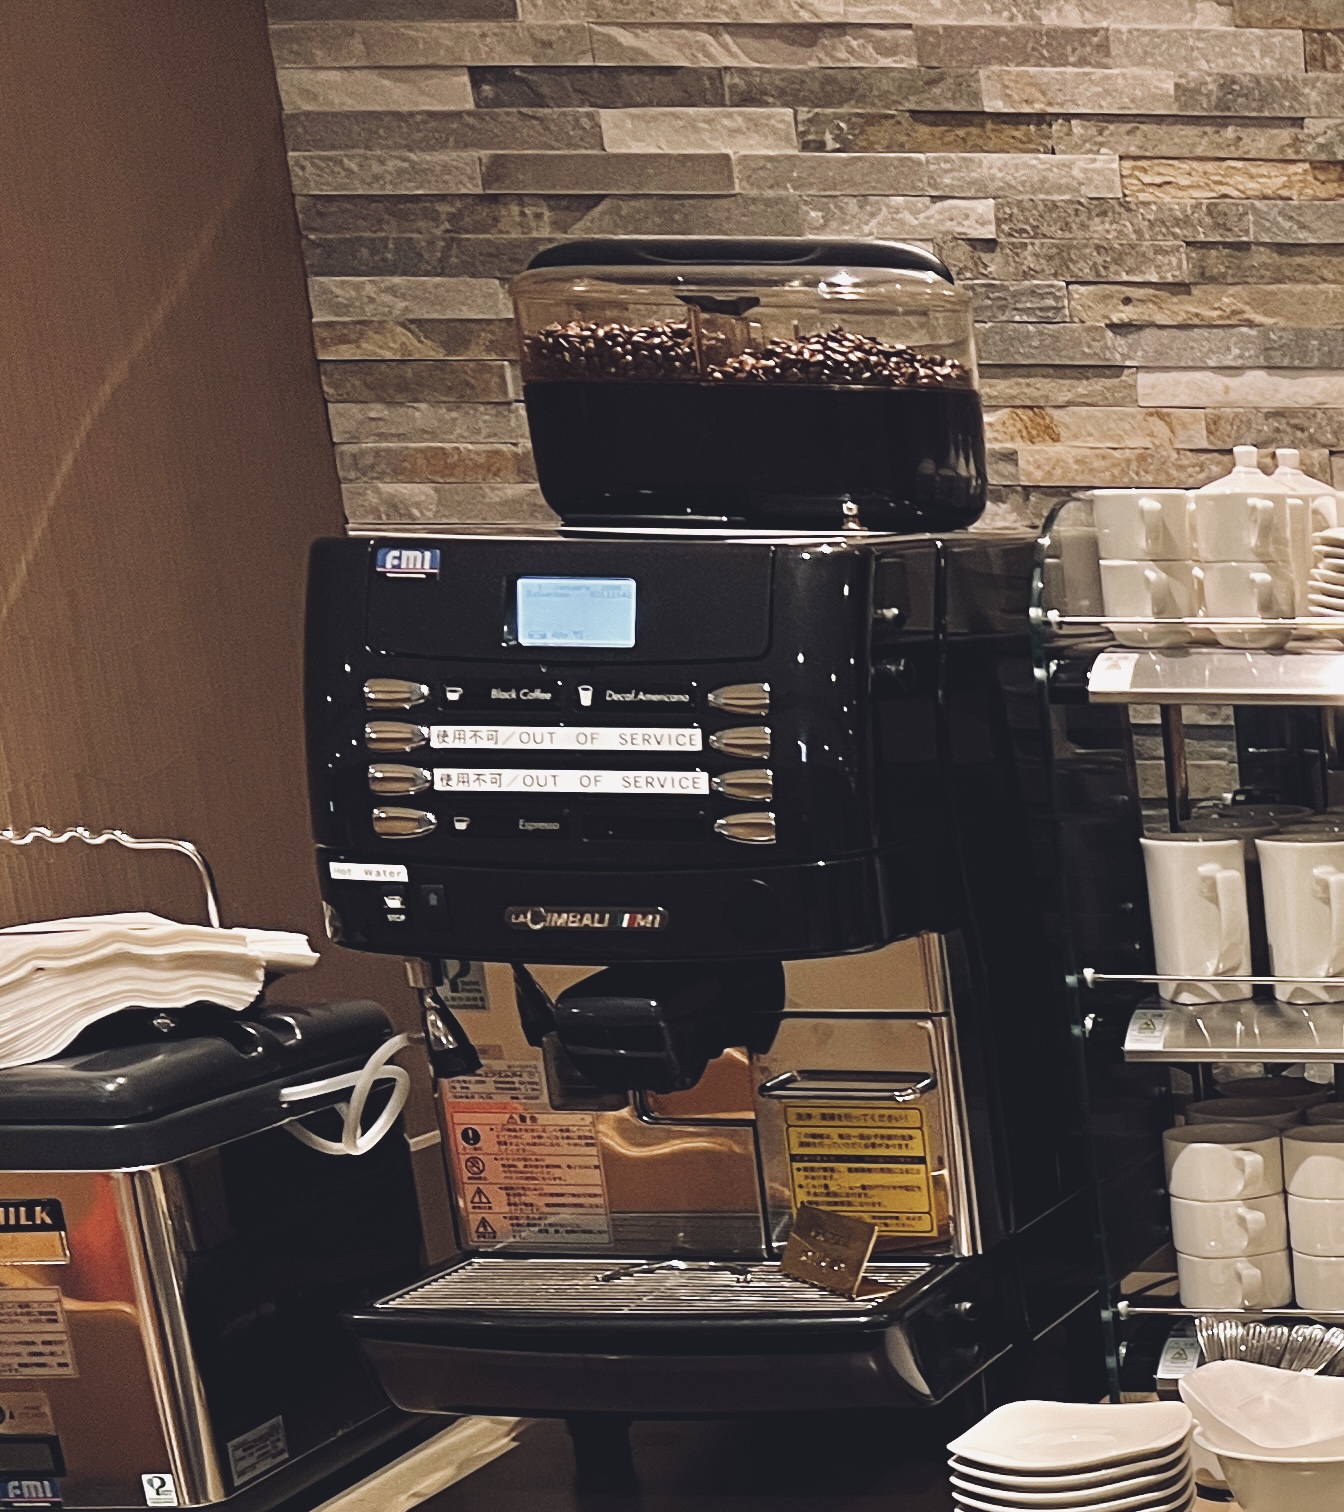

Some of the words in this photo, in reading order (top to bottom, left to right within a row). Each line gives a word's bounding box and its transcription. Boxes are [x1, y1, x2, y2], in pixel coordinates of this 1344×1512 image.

[576, 733, 599, 746] OF
[619, 734, 697, 747] SERVICE
[580, 775, 603, 788] OF
[622, 776, 702, 790] SERVICE
[363, 868, 403, 878] Water
